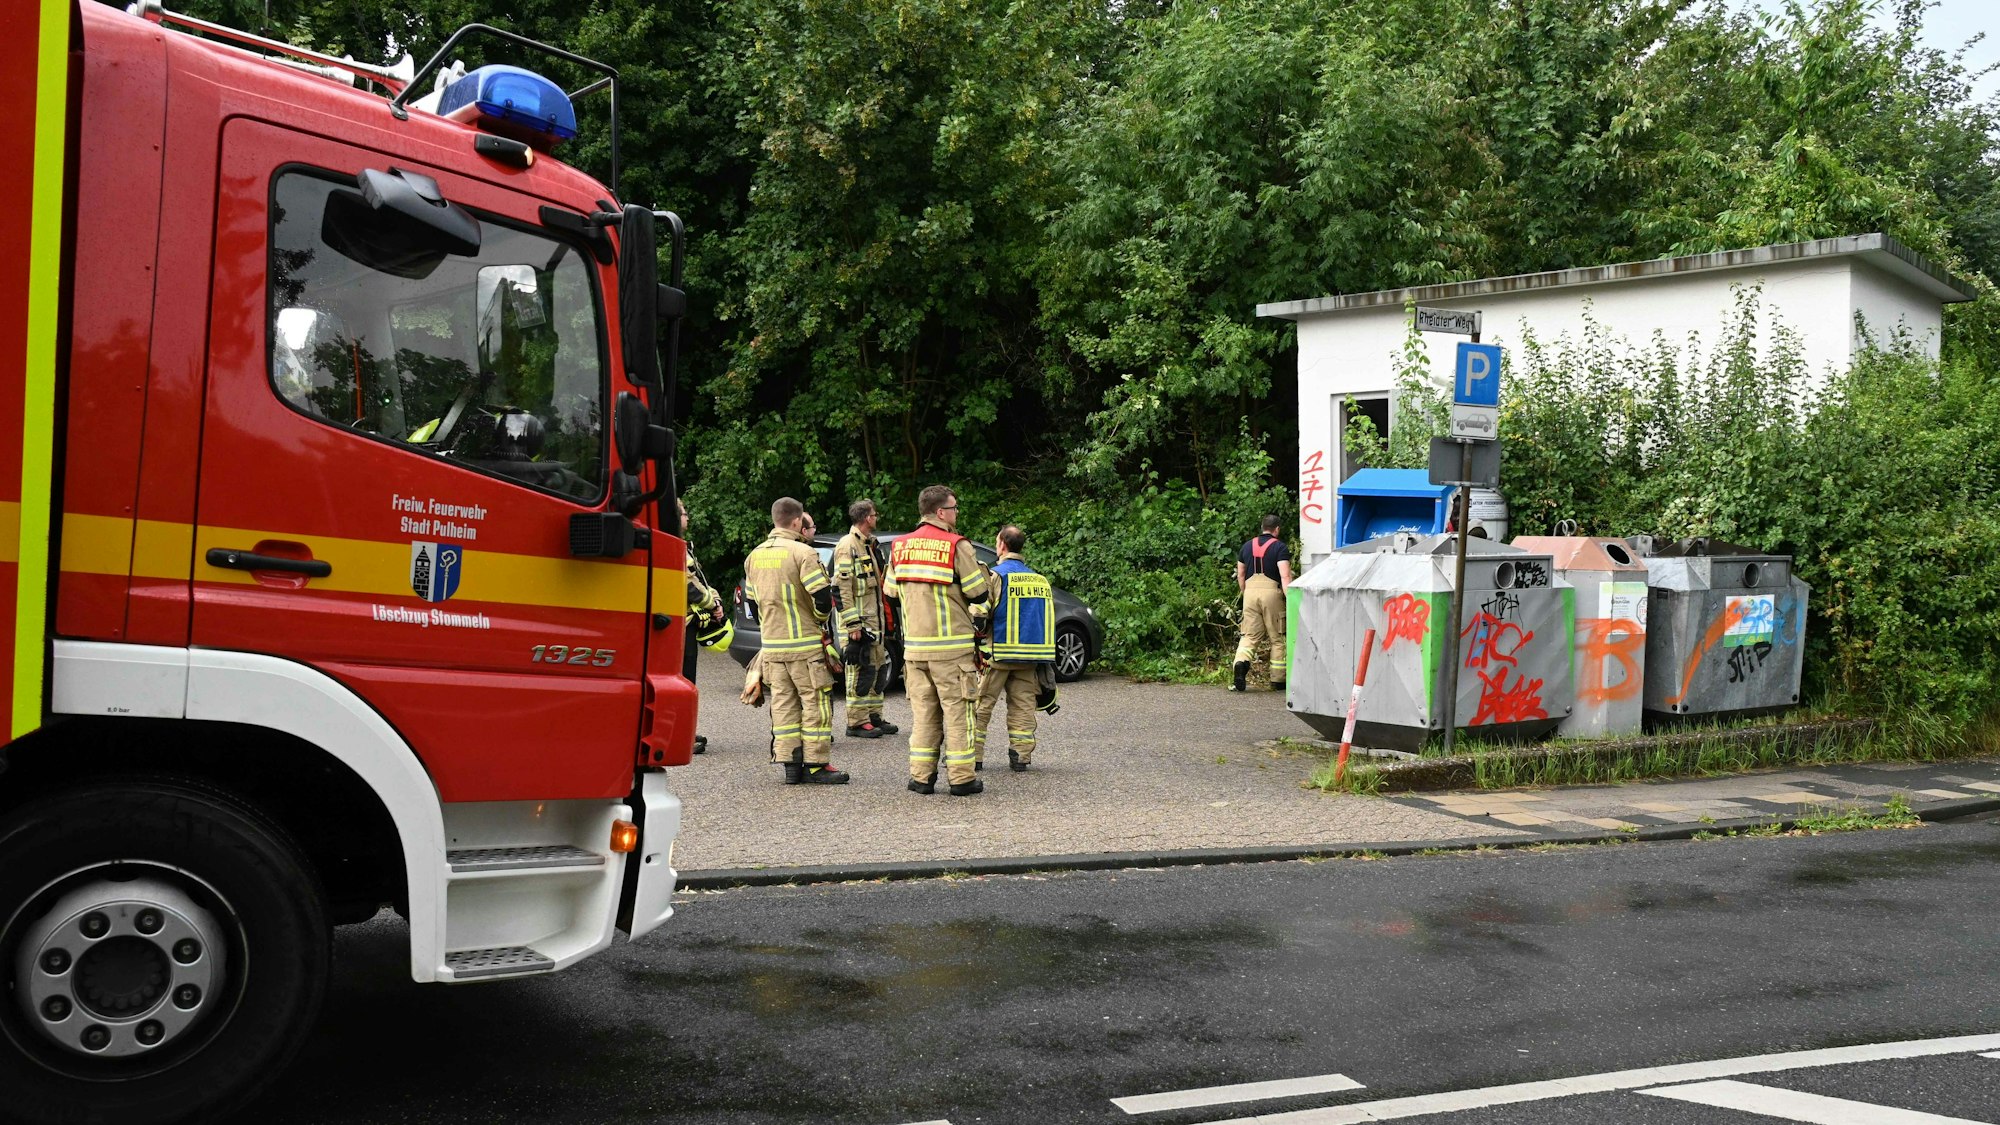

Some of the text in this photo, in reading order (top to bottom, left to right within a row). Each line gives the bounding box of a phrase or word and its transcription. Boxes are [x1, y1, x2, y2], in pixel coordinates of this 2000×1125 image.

[1465, 351, 1490, 397] P
[392, 493, 488, 521] Freiw. Feuerwehr
[400, 516, 477, 541] Stadt Pulheim
[900, 549, 950, 564] STOMMELN
[904, 537, 952, 559] ZUGFÜHRER
[1009, 586, 1025, 597] PUL
[371, 603, 491, 630] Löschzug Stommeln
[531, 644, 616, 667] 1325
